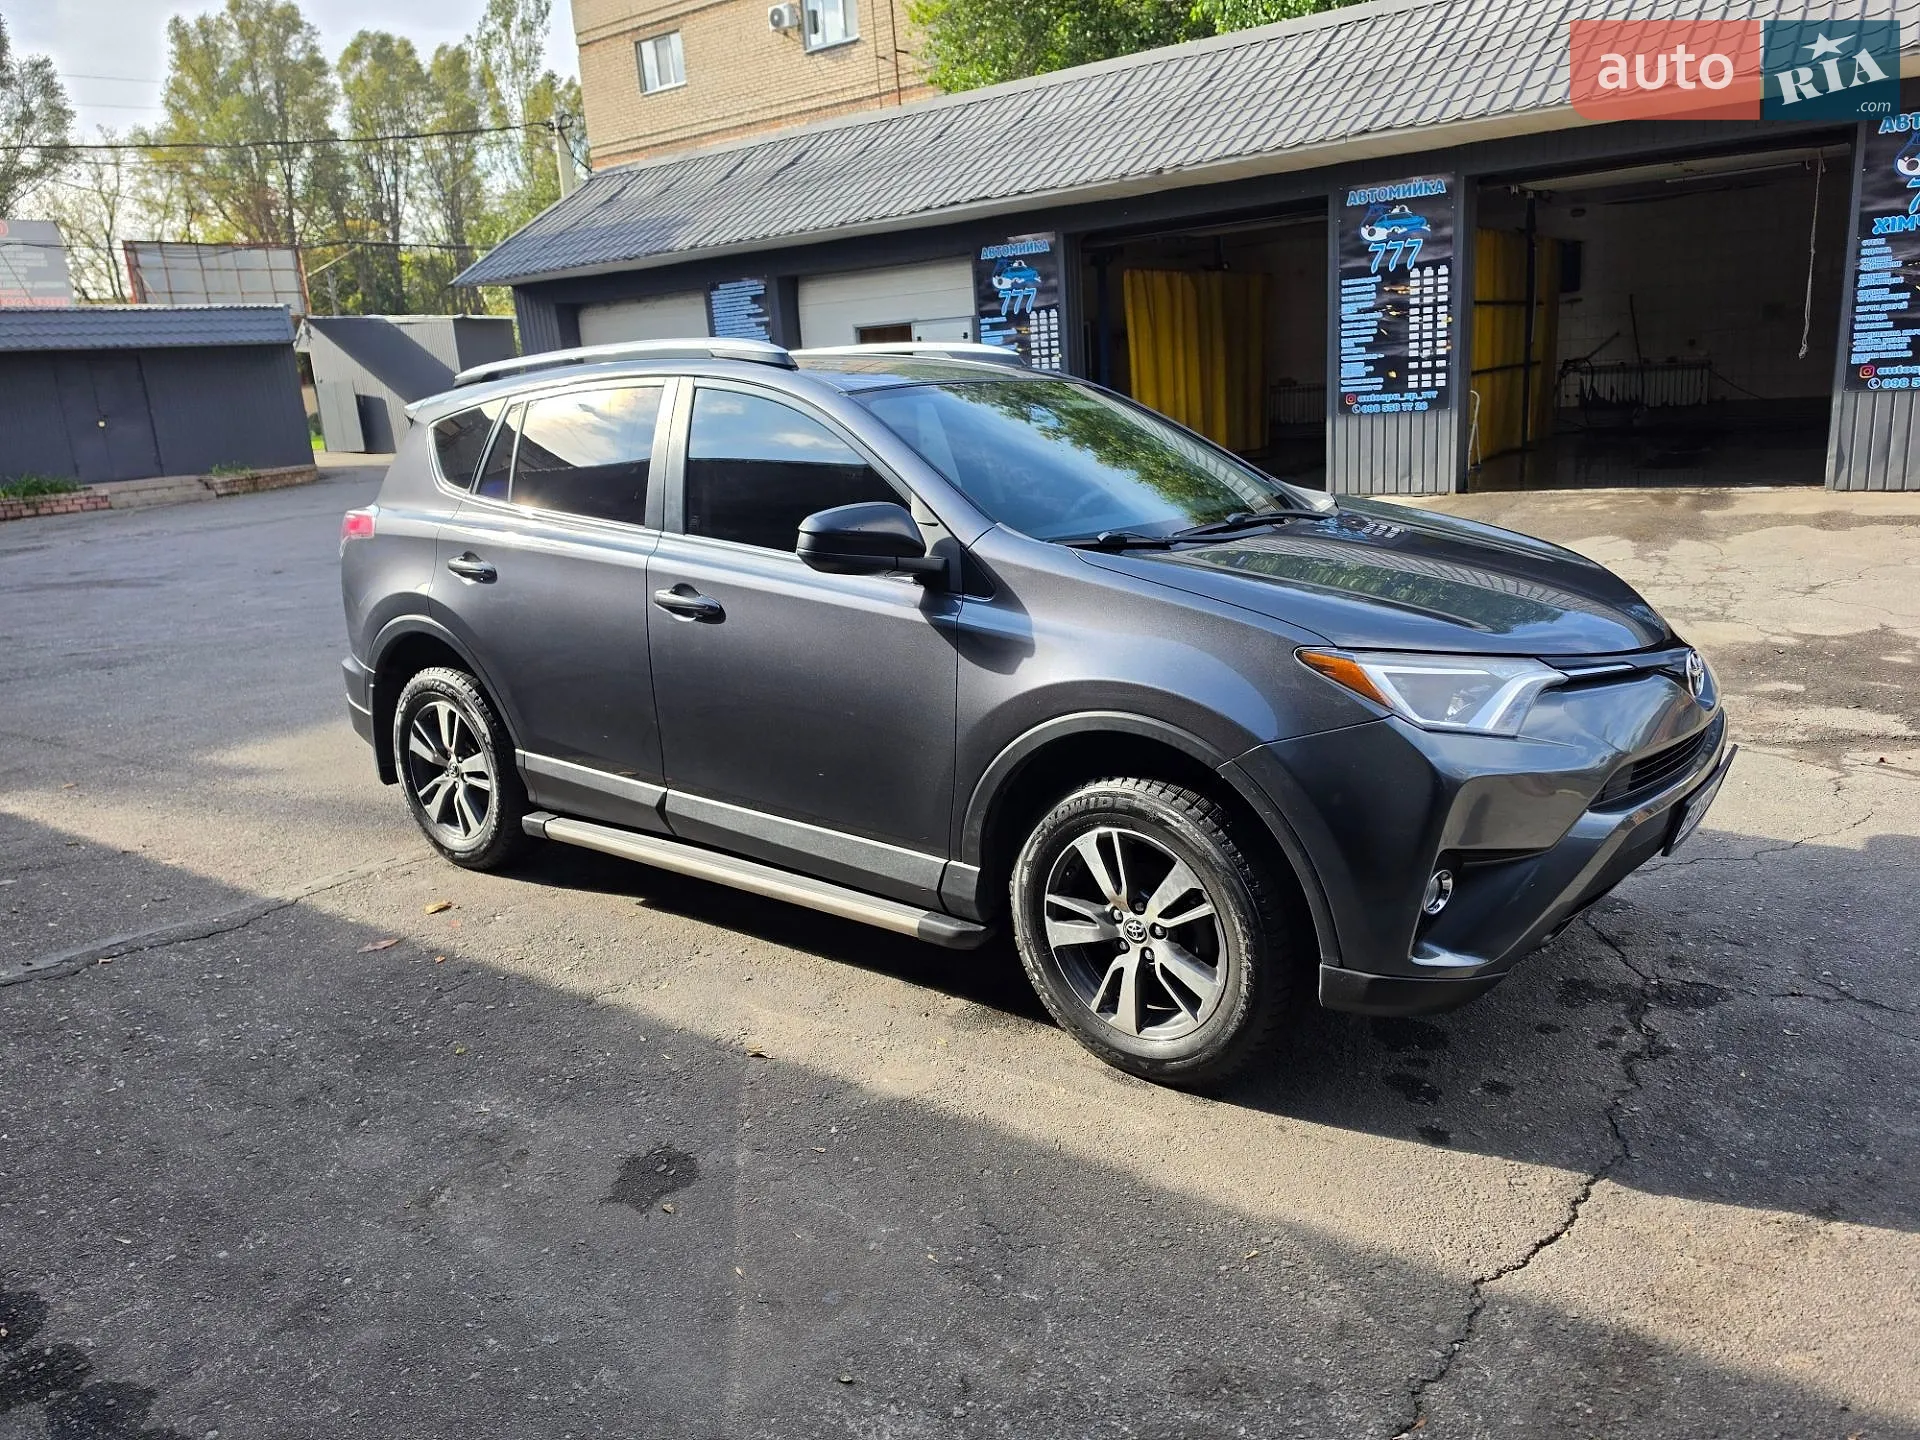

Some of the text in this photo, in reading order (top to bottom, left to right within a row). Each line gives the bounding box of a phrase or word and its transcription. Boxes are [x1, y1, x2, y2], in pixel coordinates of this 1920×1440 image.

[1346, 176, 1446, 206] АВТОМИЙКА
[981, 239, 1050, 260] АВТОМИЙКА
[1368, 238, 1423, 274] 777
[998, 288, 1037, 316] 777
